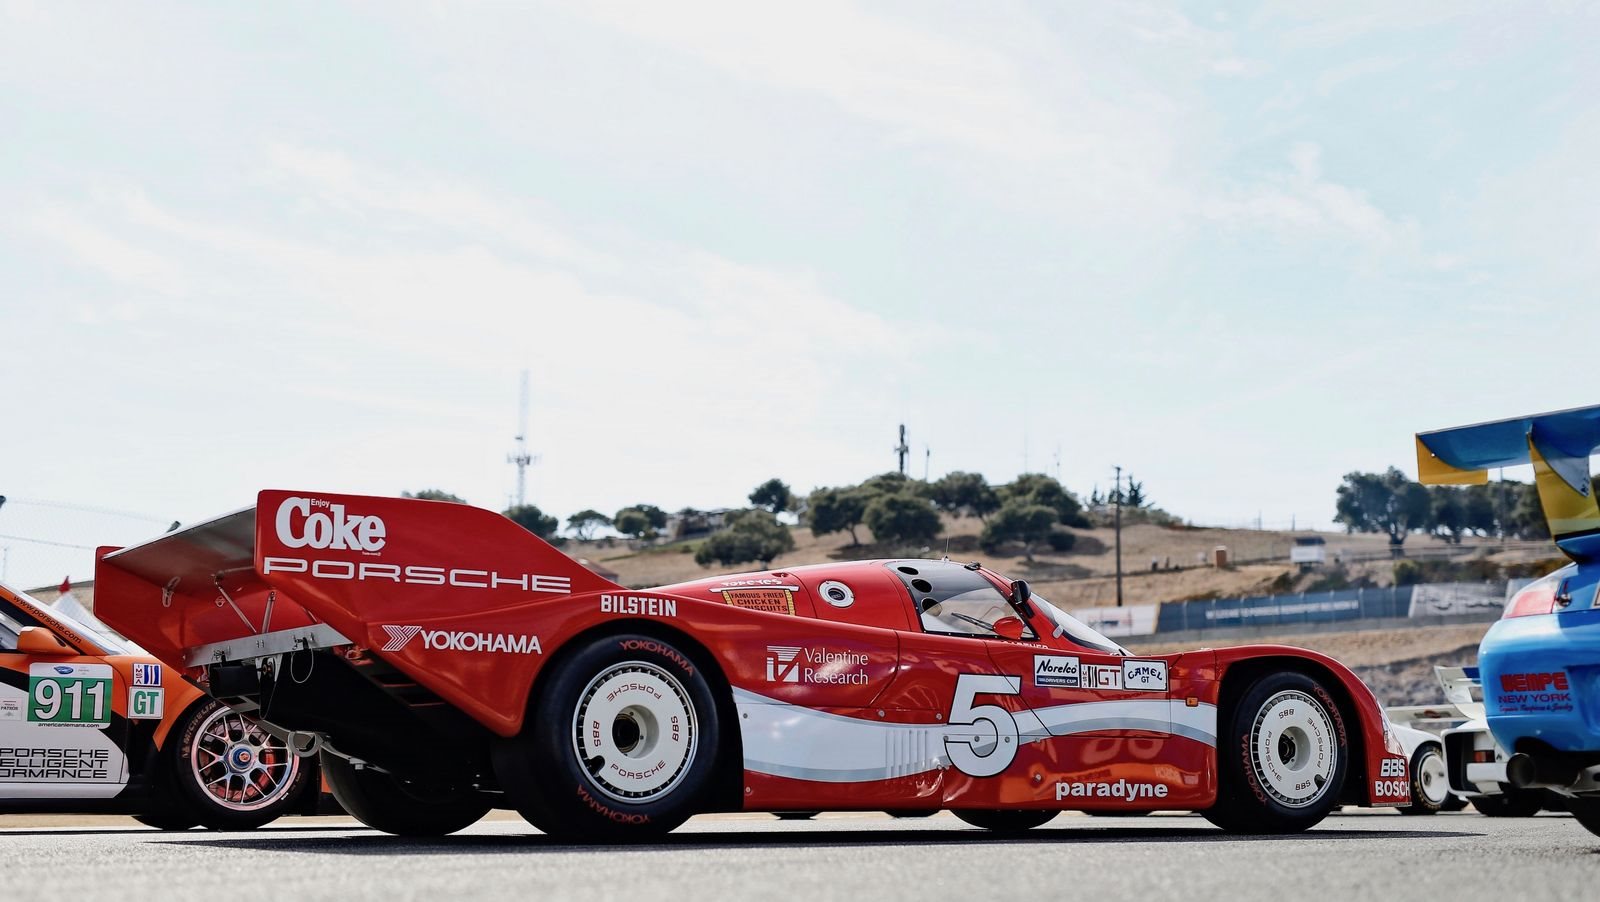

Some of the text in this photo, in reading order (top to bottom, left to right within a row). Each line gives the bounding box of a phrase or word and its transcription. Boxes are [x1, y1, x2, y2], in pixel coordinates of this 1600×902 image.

[310, 498, 330, 508] Enjoy
[275, 496, 386, 552] Coke
[263, 556, 571, 594] PORSCHE
[600, 594, 677, 617] BILSTEIN
[13, 594, 82, 644] www.porsche.com
[420, 629, 542, 655] YOKOHAMA
[619, 639, 695, 678] YOKOHAMA
[804, 647, 869, 665] Valentine
[1036, 658, 1078, 674] Norelco
[804, 667, 869, 685] Research
[1098, 669, 1120, 687] GT
[1127, 666, 1163, 681] CAMEL
[1141, 676, 1150, 684] GT
[34, 678, 106, 721] 911
[133, 690, 160, 715] GT
[606, 683, 663, 703] PORSCHE
[1498, 692, 1571, 703] NEW YORK
[944, 672, 1022, 777] 5
[1278, 708, 1295, 720] BBS
[1312, 682, 1346, 748] YOKOHAMA
[592, 720, 602, 748] BBS
[670, 715, 680, 742] BBS
[0, 748, 109, 759] PORSCHE
[1307, 717, 1324, 769] PORSCHE
[1265, 730, 1283, 783] PORSCHE
[1380, 758, 1406, 777] BBS
[610, 760, 667, 780] PORSCHE
[1241, 733, 1268, 806] YOKOHAMA
[1055, 778, 1168, 802] paradyne
[1295, 779, 1311, 791] BBS
[1374, 780, 1411, 797] BOSCH
[576, 784, 651, 824] YOKOHAMA
